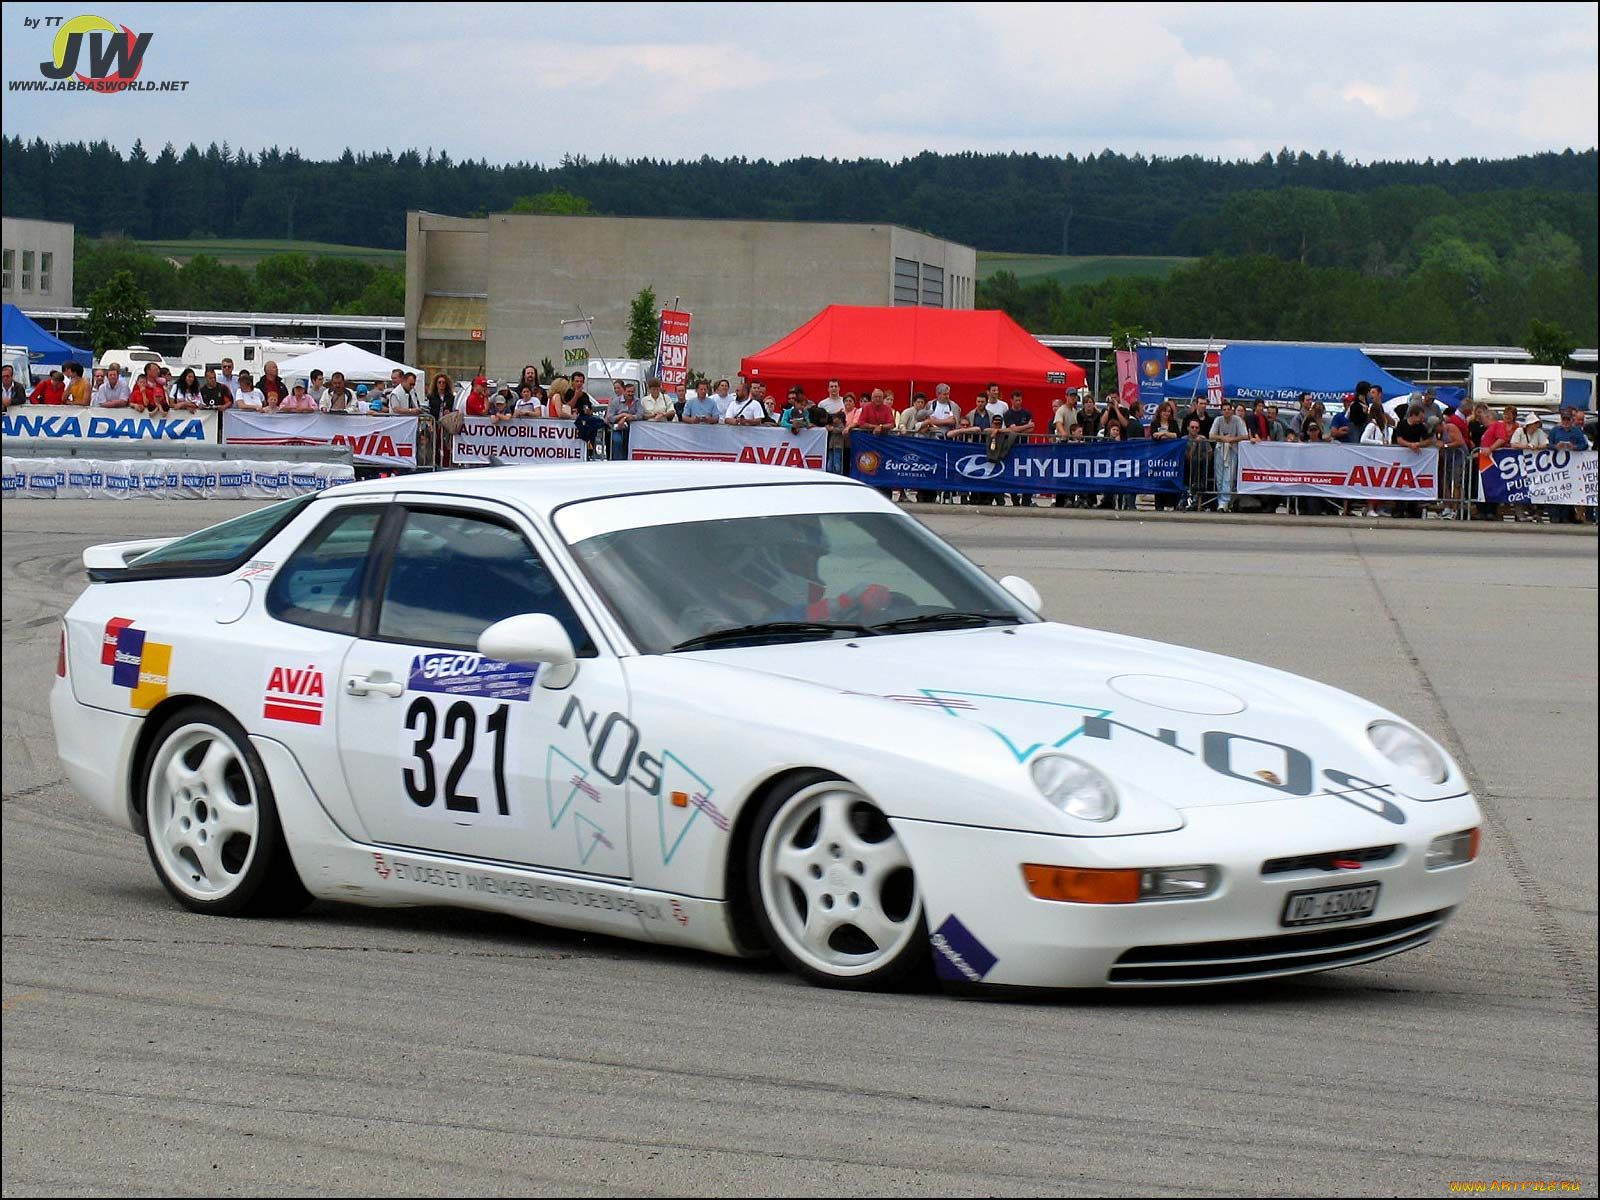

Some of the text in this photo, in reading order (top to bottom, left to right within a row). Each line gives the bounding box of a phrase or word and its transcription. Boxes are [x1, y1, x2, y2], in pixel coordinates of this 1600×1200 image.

[1237, 388, 1274, 399] RACING
[87, 417, 205, 440] DANKA
[459, 424, 537, 438] AUTOMOBIL
[457, 443, 497, 456] REVUE
[499, 445, 581, 459] AUTOMOBILE
[739, 442, 804, 468] AVIA
[885, 459, 938, 474] Euro 2004
[1014, 458, 1140, 478] HYUNDAI
[1348, 462, 1417, 489] AVIA
[1499, 450, 1571, 480] SECO
[1506, 470, 1570, 491] PUBLICITE
[424, 656, 480, 678] SECO
[266, 664, 324, 697] AVIA
[403, 696, 510, 816] 321
[558, 694, 663, 796] NOS
[1082, 715, 1405, 825] NOS
